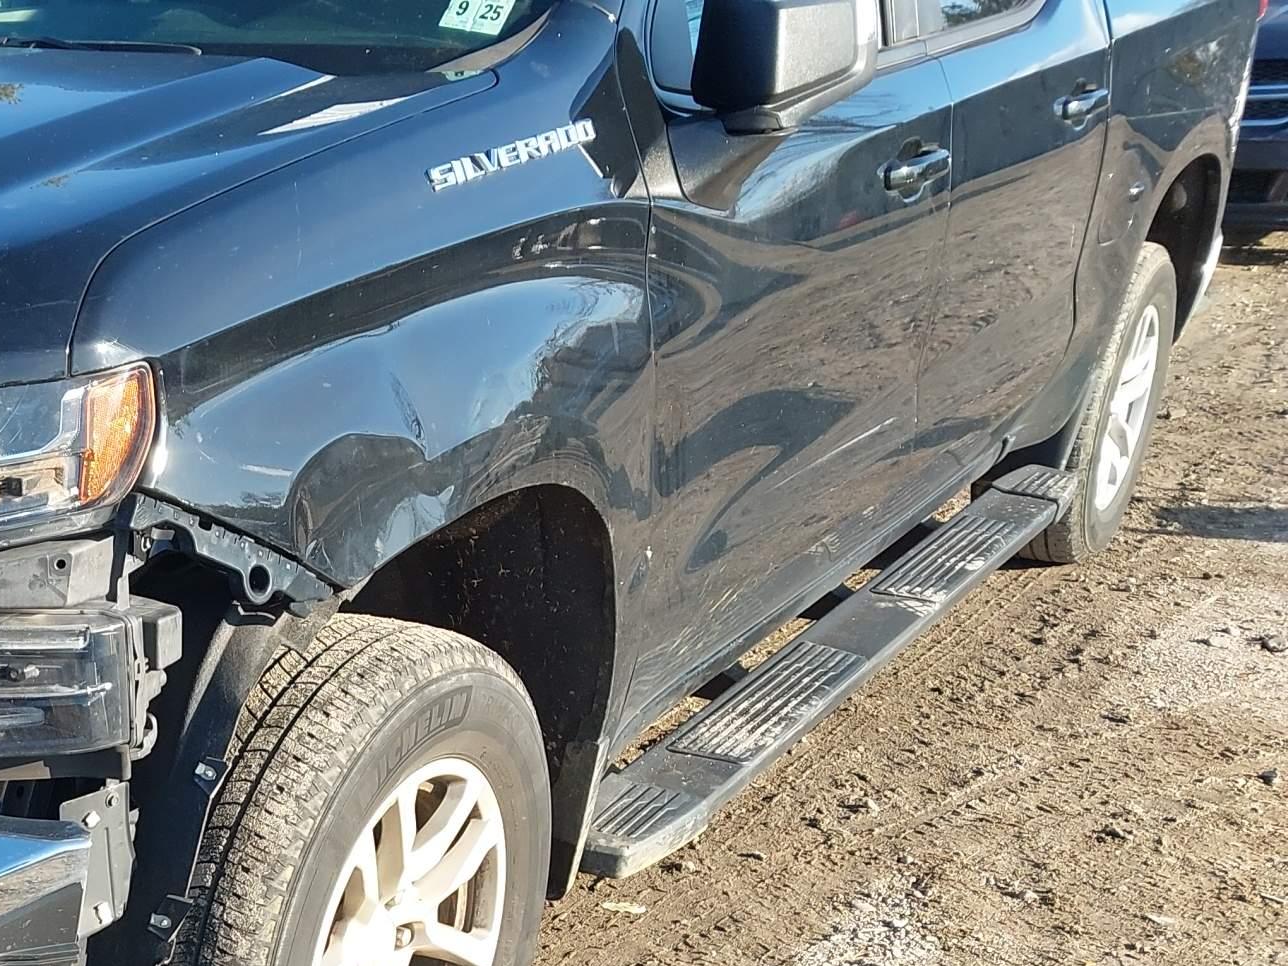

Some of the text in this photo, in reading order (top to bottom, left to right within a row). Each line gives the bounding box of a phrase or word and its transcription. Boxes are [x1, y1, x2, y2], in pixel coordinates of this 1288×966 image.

[455, 0, 504, 21] 9 25
[425, 118, 597, 192] SILVERADO
